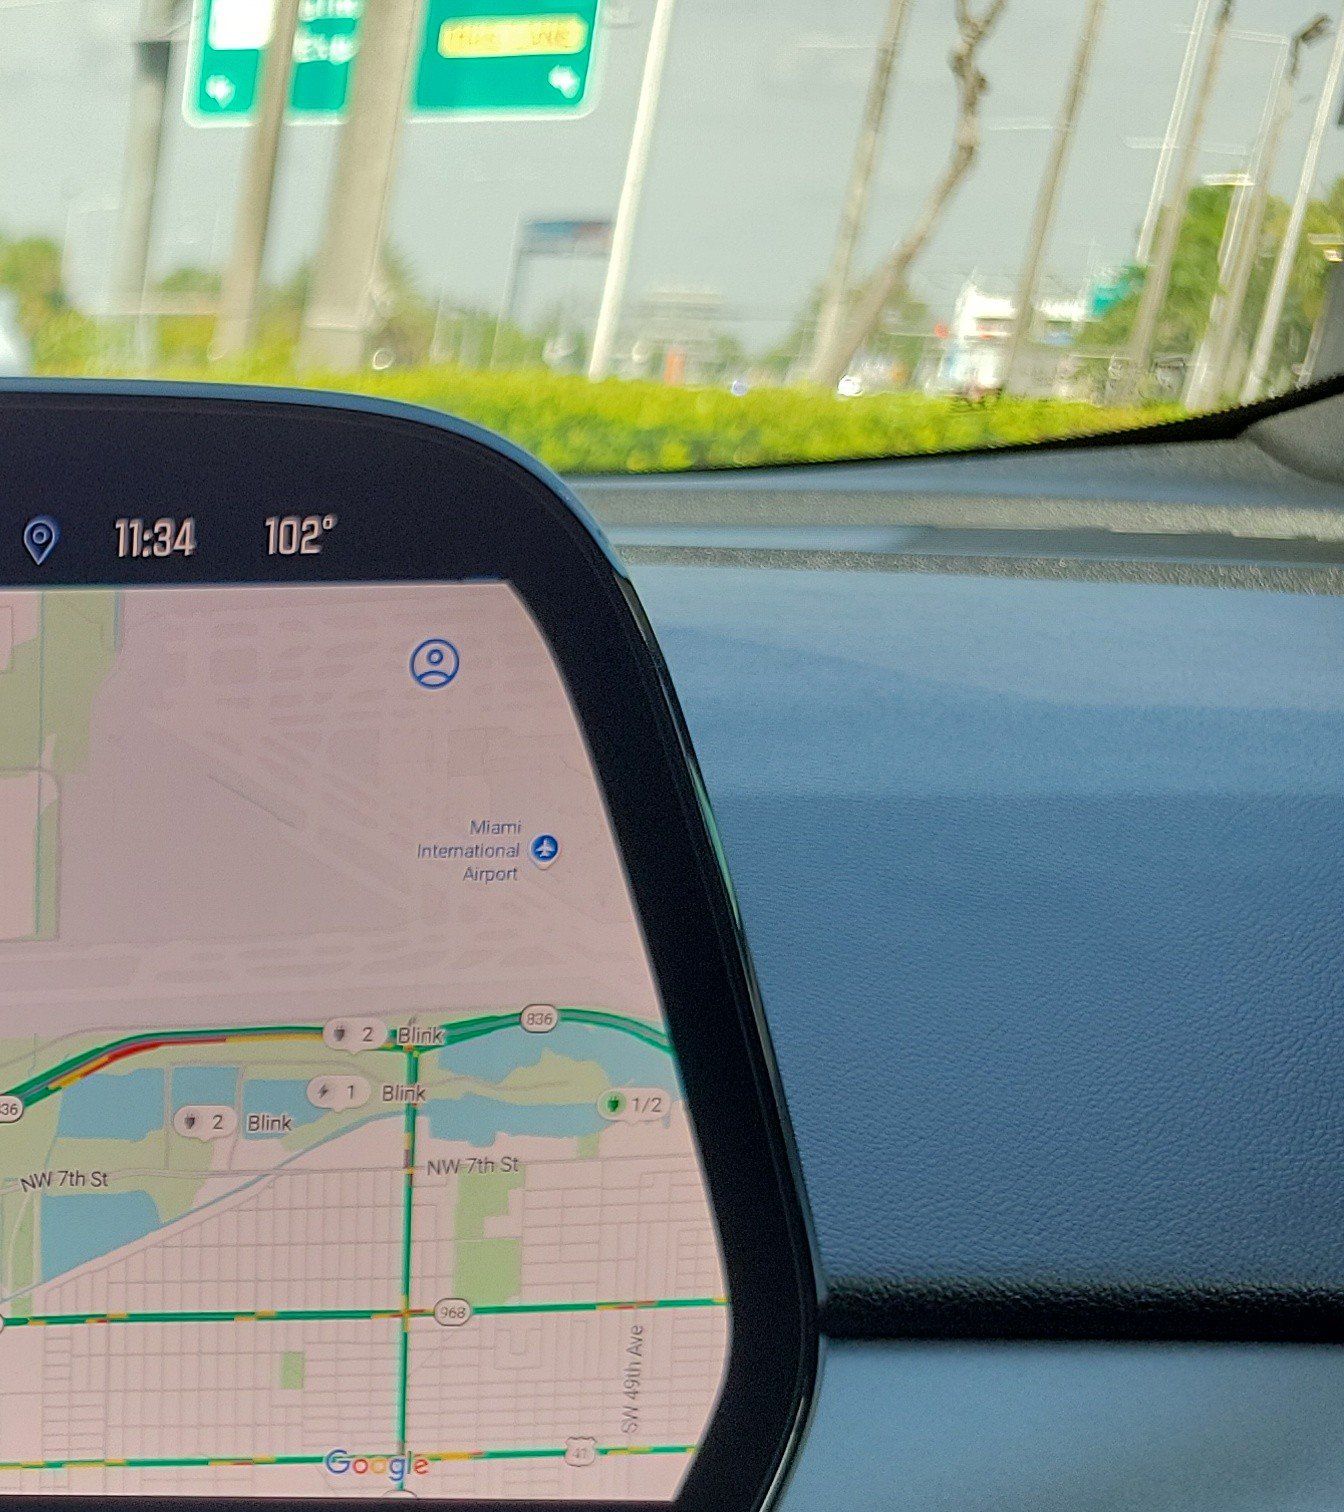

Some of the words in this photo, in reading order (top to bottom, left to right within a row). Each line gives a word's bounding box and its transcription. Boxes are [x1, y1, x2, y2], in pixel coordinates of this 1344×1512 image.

[115, 518, 195, 557] 11:34
[265, 514, 337, 555] 102°
[470, 820, 522, 835] Miami
[417, 843, 520, 859] International
[463, 866, 518, 884] Airport
[526, 1011, 553, 1026] 836
[362, 1027, 373, 1041] 2
[398, 1026, 444, 1045] Blink
[346, 1085, 354, 1099] 1
[382, 1083, 426, 1103] Blink
[631, 1096, 662, 1113] 1/2
[212, 1115, 223, 1130] 2
[248, 1114, 292, 1132] Blink
[427, 1159, 460, 1176] NW
[465, 1158, 496, 1174] 7th
[500, 1157, 519, 1173] St
[21, 1170, 52, 1192] NW
[57, 1170, 85, 1188] 7th
[89, 1170, 108, 1187] St
[440, 1304, 466, 1319] 968
[626, 1325, 644, 1357] Ave
[623, 1361, 642, 1400] 49th
[621, 1405, 638, 1434] SW
[326, 1448, 429, 1481] Google
